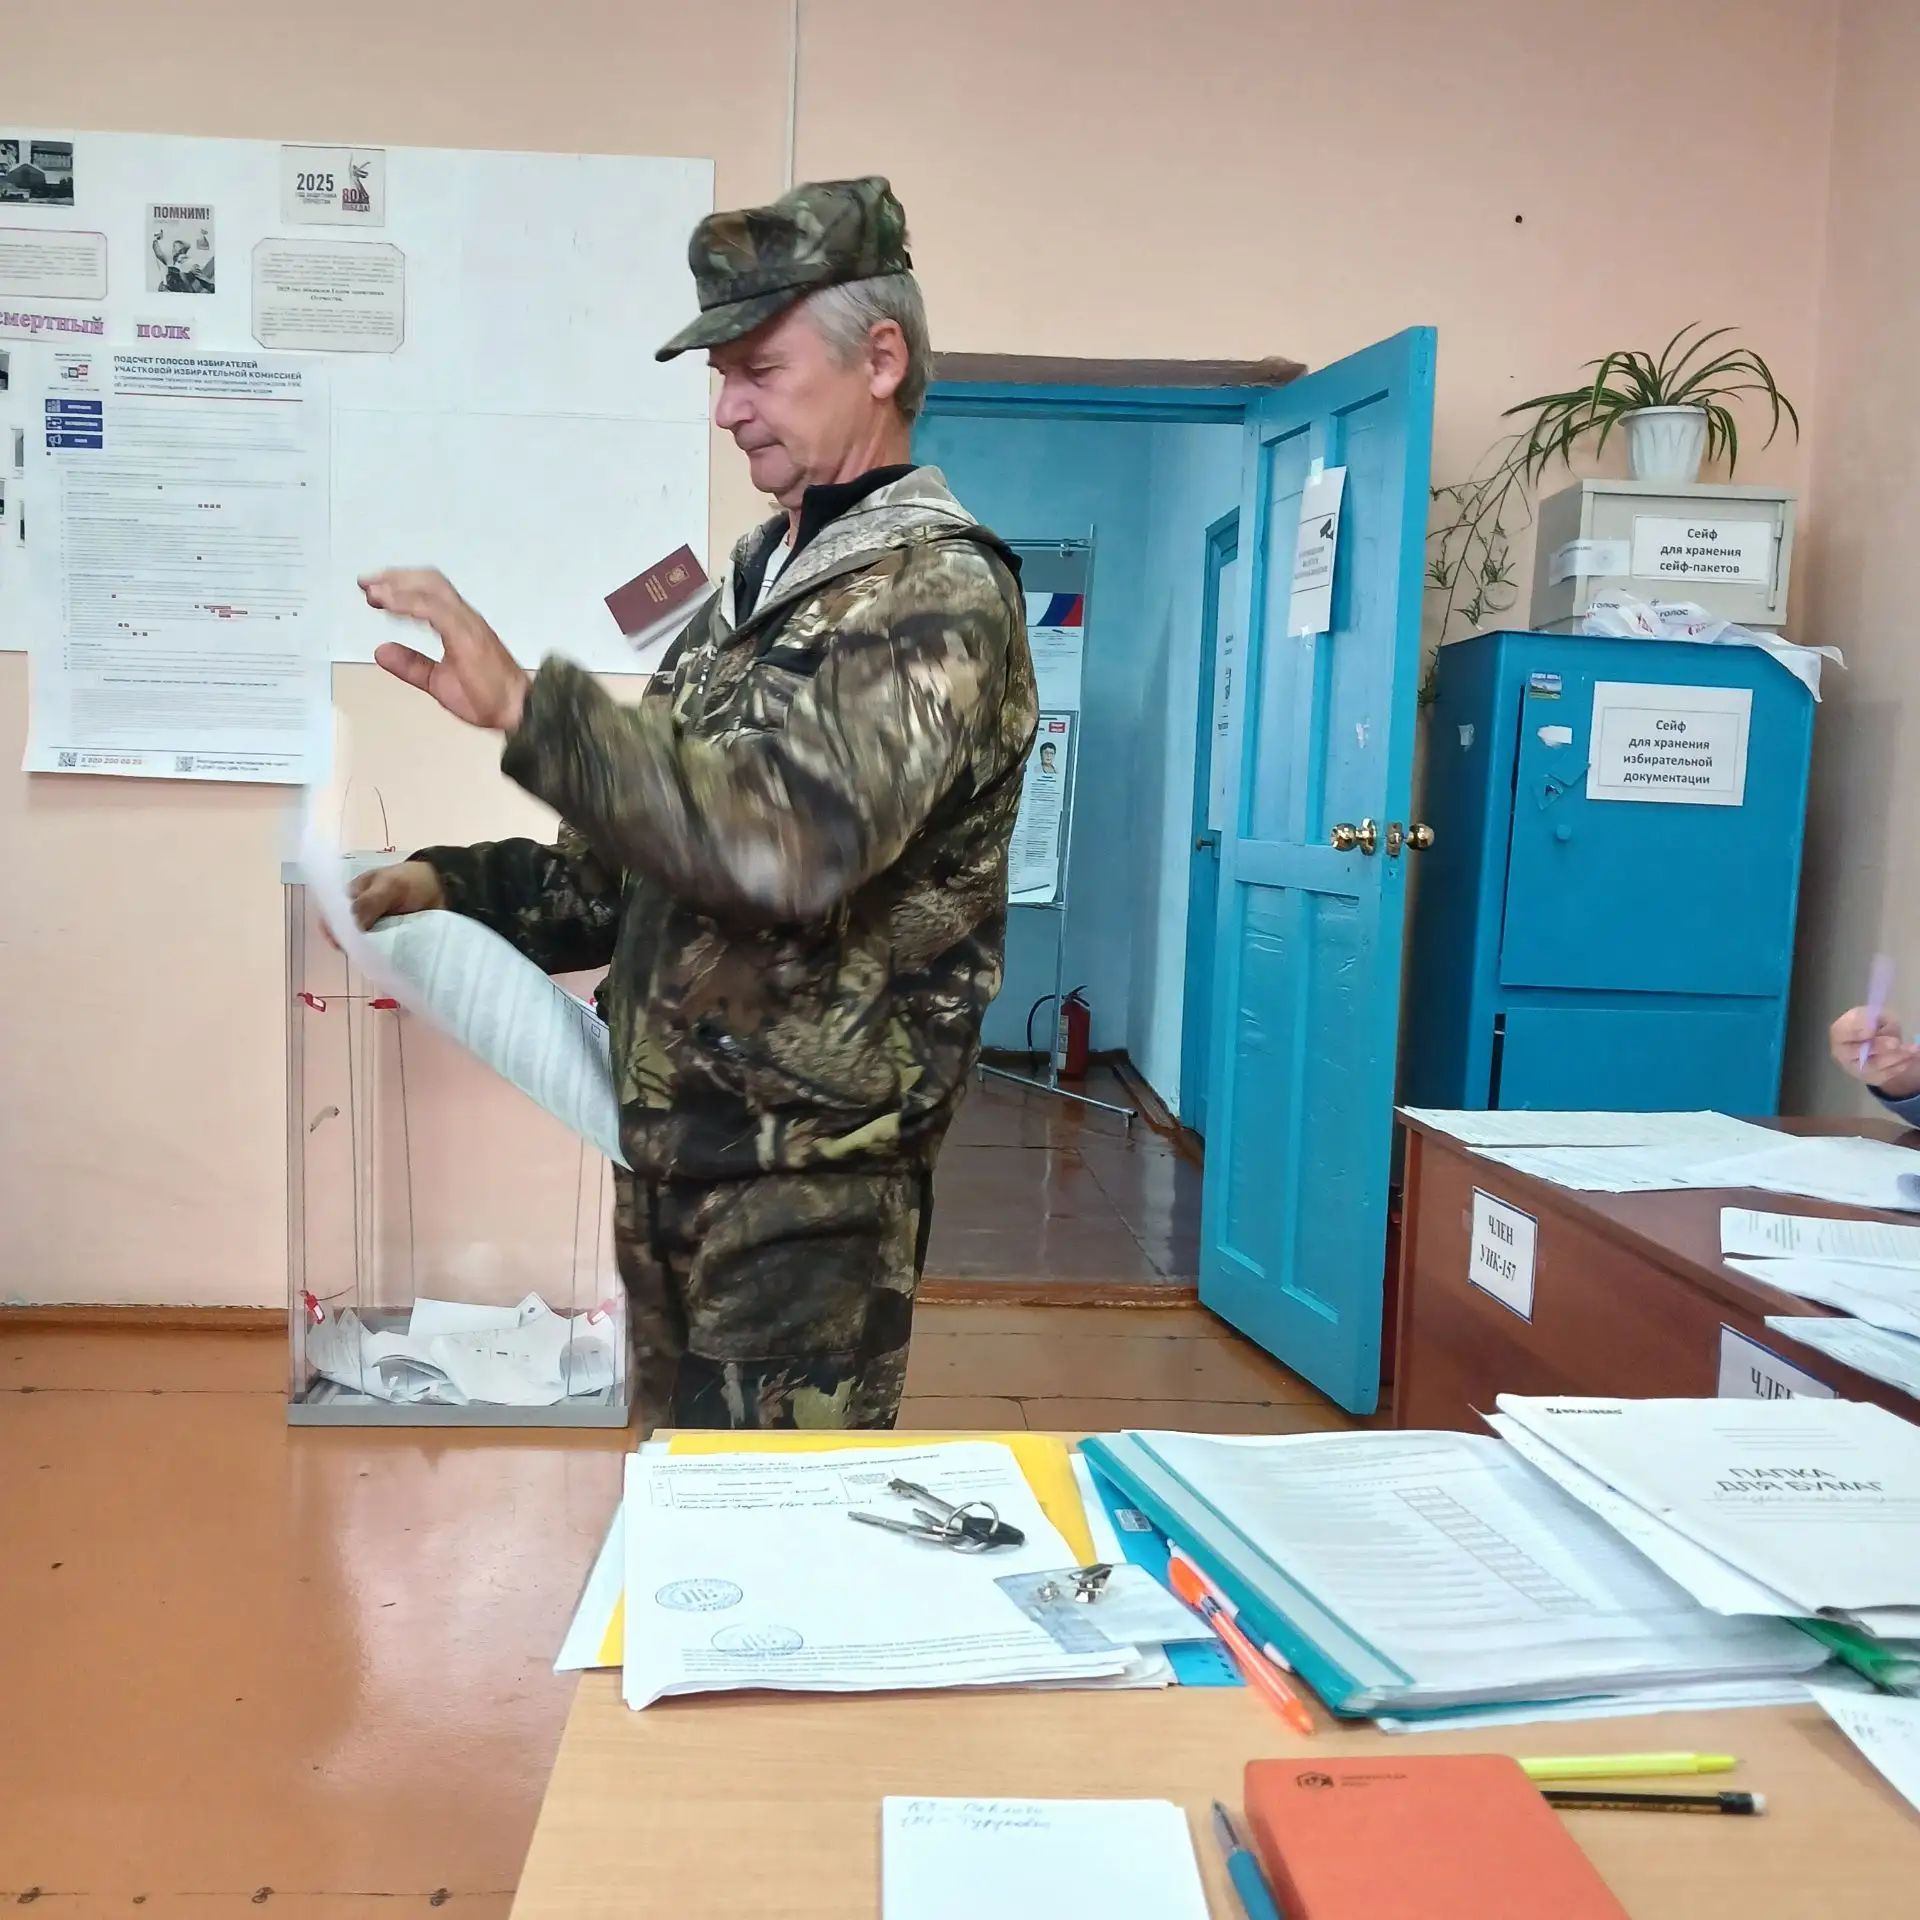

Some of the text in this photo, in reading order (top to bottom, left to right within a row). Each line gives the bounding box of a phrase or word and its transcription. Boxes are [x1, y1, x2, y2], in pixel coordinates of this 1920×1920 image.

[297, 173, 334, 191] 2025
[153, 206, 210, 220] ПОМНИМ!
[136, 323, 191, 340] полк
[114, 355, 258, 368] ПОДСЧЕТ ГОЛОСОВ ИЗБИРАТЕЛЕЙ
[114, 366, 302, 380] УЧАСТКОВОЙ ИЗБИРАТЕЛЬНОЙ КОМИССИЕЙ
[1687, 528, 1718, 541] Сейф
[1660, 546, 1742, 557] для хранения
[1660, 560, 1740, 573] сейф-пакетов
[1656, 719, 1687, 733] Сейф
[1628, 738, 1710, 750] для хранения
[1623, 753, 1713, 767] избирательной
[1623, 772, 1710, 786] документации
[1488, 1214, 1513, 1245] ЧЛЕН
[1480, 1244, 1517, 1281] УИК-157
[1728, 1468, 1836, 1478] ПАПКА
[1716, 1480, 1884, 1492] ДЛЯ БУМАГ
